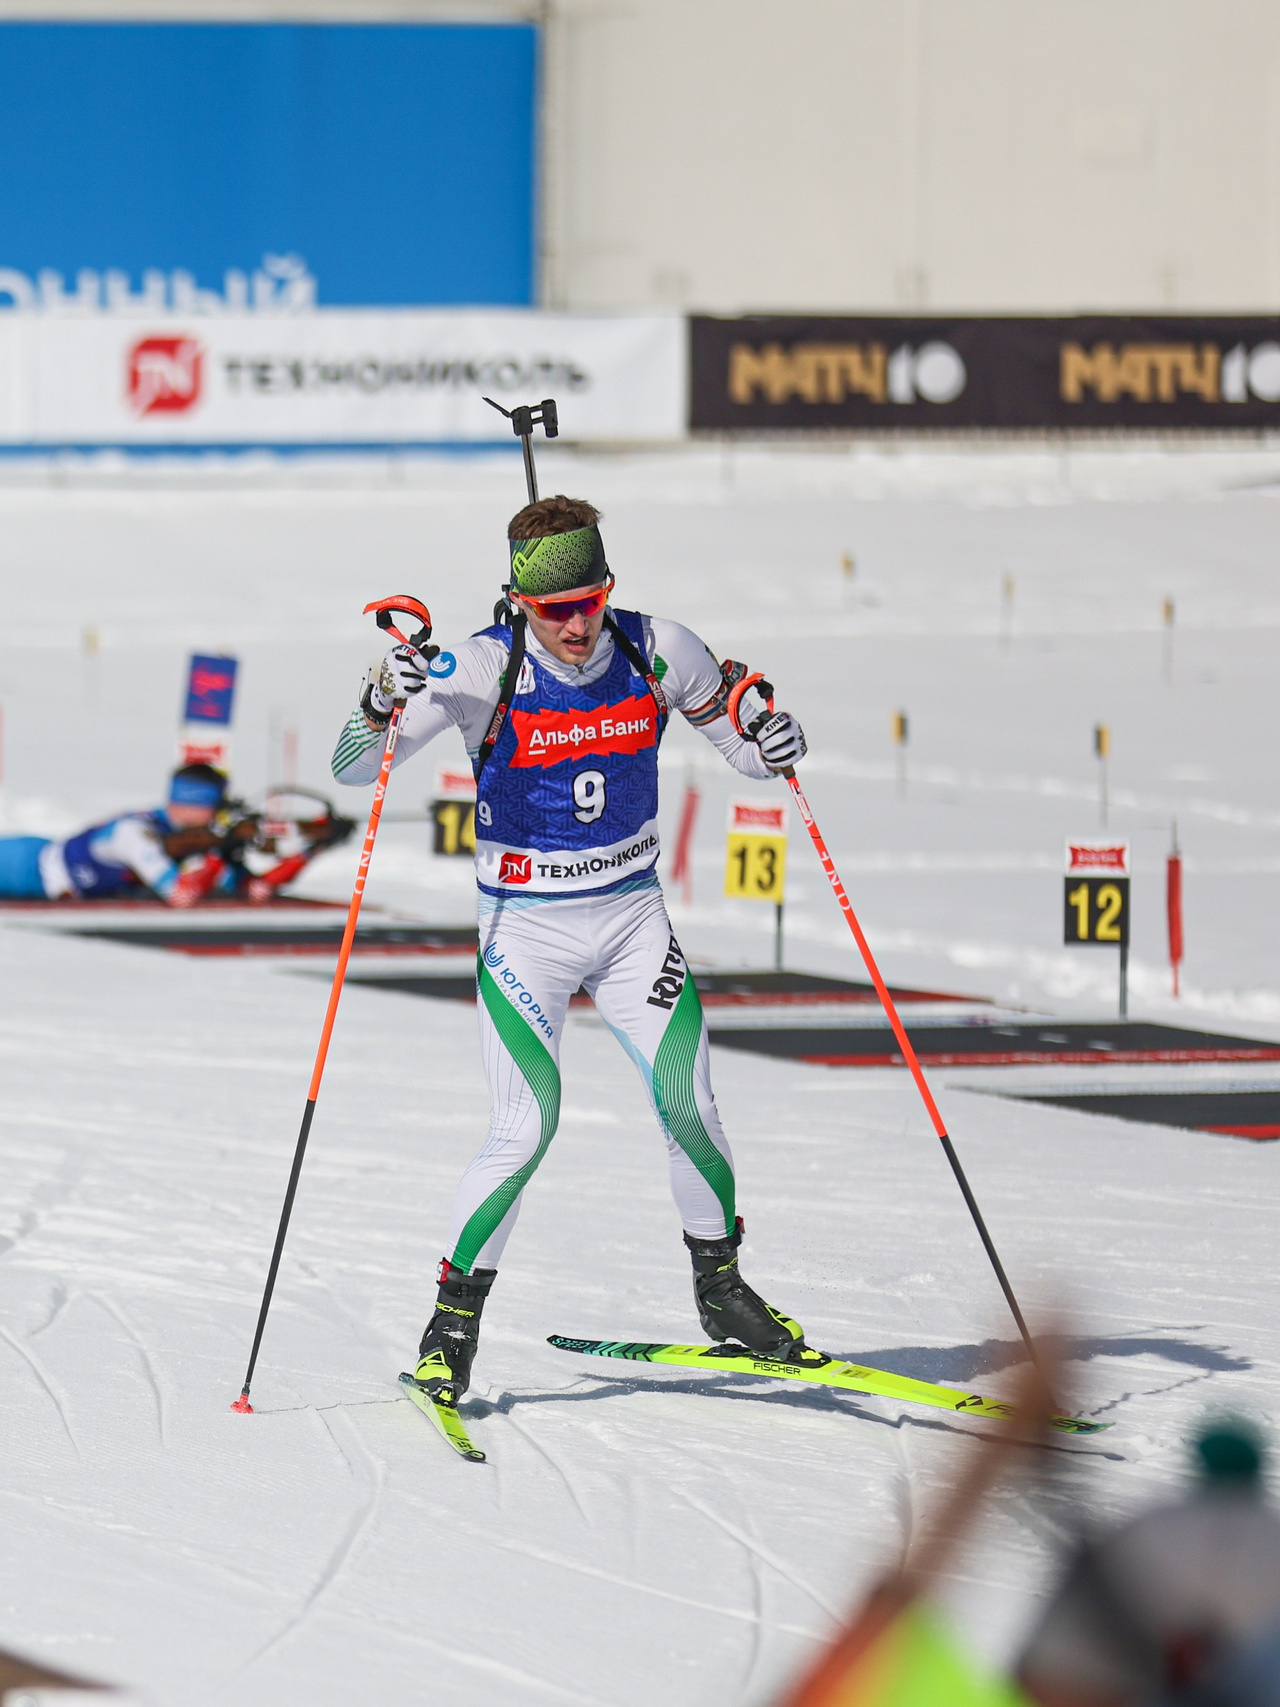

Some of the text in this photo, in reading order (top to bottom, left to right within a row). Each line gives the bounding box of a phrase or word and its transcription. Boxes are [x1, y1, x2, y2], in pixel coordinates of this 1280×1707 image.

[222, 351, 591, 394] ТЕХНОНИКОЛЬ
[528, 717, 650, 747] Альфа Банк
[478, 800, 494, 827] 9
[572, 768, 607, 824] 9
[536, 834, 658, 878] ТЕХНОНИКОЛЬ
[733, 845, 777, 893] 13
[1069, 882, 1122, 942] 12
[494, 975, 536, 1027] СТРАХОВАНИЕ
[500, 967, 554, 1038] ЮГОРИЯ
[753, 1362, 801, 1375] FISCHER
